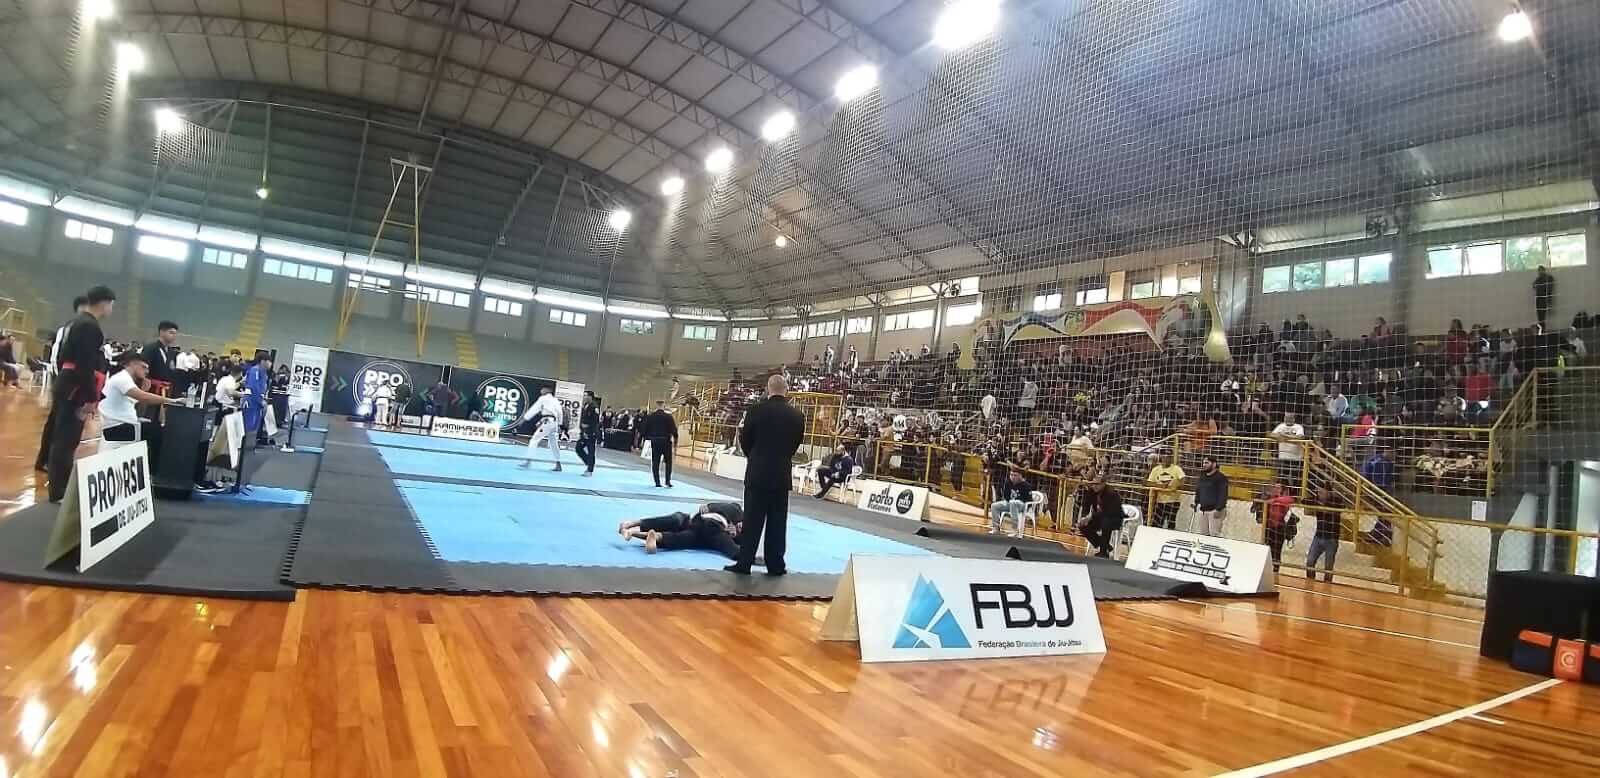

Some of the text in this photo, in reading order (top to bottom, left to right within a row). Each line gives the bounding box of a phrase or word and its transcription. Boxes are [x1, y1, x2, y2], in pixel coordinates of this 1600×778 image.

[295, 365, 322, 376] PRO
[484, 385, 520, 401] PRO
[494, 400, 518, 414] RS
[867, 486, 893, 508] porto
[1160, 545, 1230, 570] FRJJ
[969, 583, 1075, 629] FBJJ
[977, 640, 1014, 649] Federação
